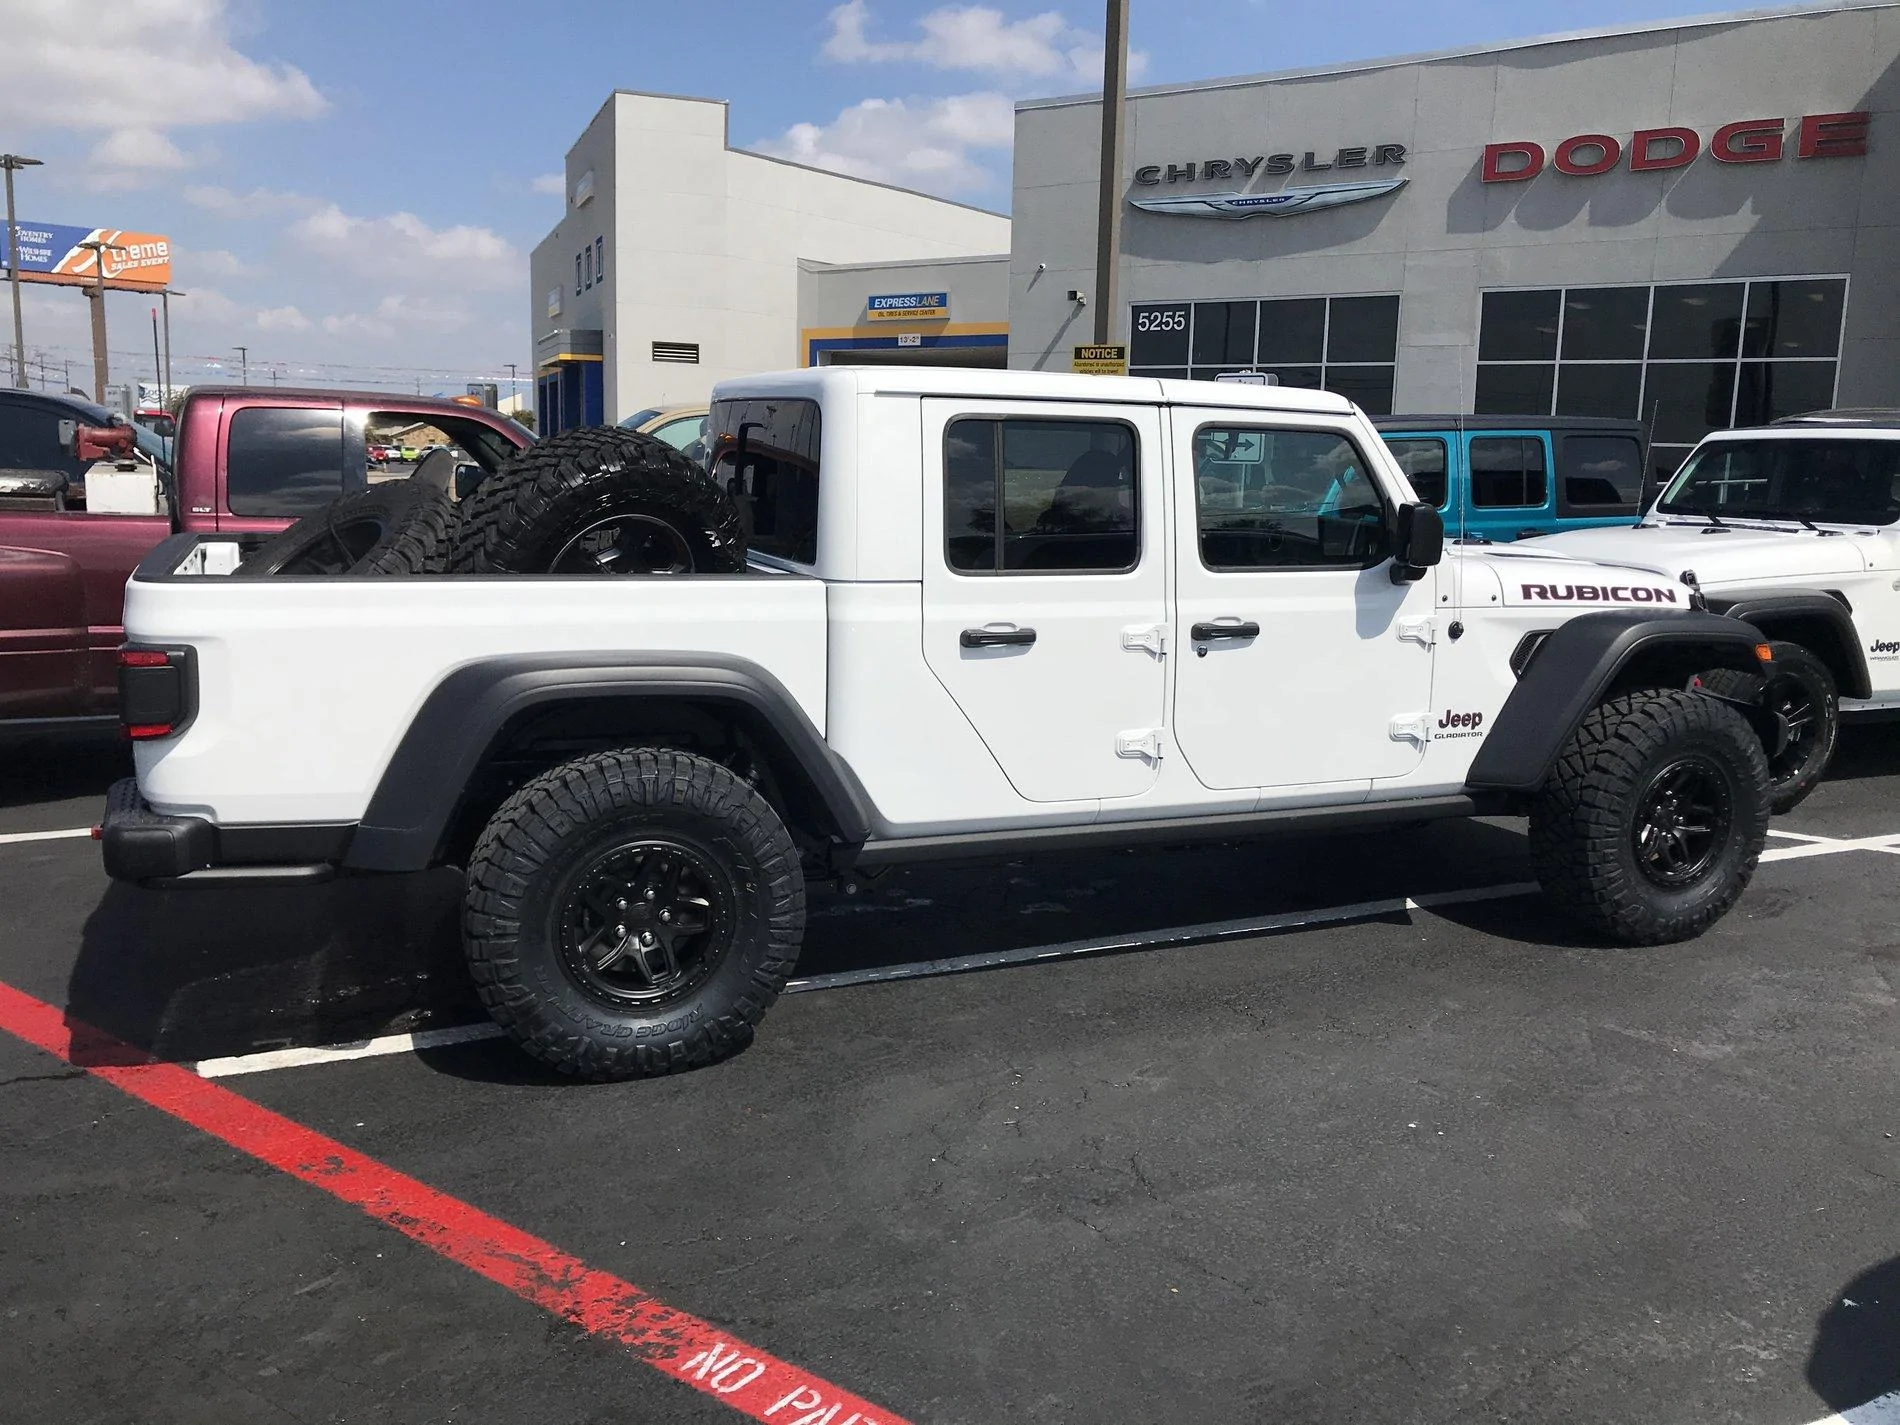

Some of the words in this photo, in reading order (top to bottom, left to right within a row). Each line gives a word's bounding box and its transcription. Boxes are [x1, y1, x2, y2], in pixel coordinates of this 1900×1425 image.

[1481, 110, 1870, 183] DODGE
[1134, 143, 1408, 185] CHRYSLER
[1231, 197, 1286, 206] CHRYSLER
[110, 260, 139, 271] SALES
[140, 256, 170, 267] EVENT
[1137, 311, 1186, 332] 5255
[1081, 348, 1118, 359] NOTICE
[1520, 583, 1678, 603] RUBICON
[1869, 639, 1900, 654] Jeep
[1438, 709, 1483, 730] Jeep
[1434, 731, 1483, 740] GLADIATOR
[679, 1342, 767, 1394] NO
